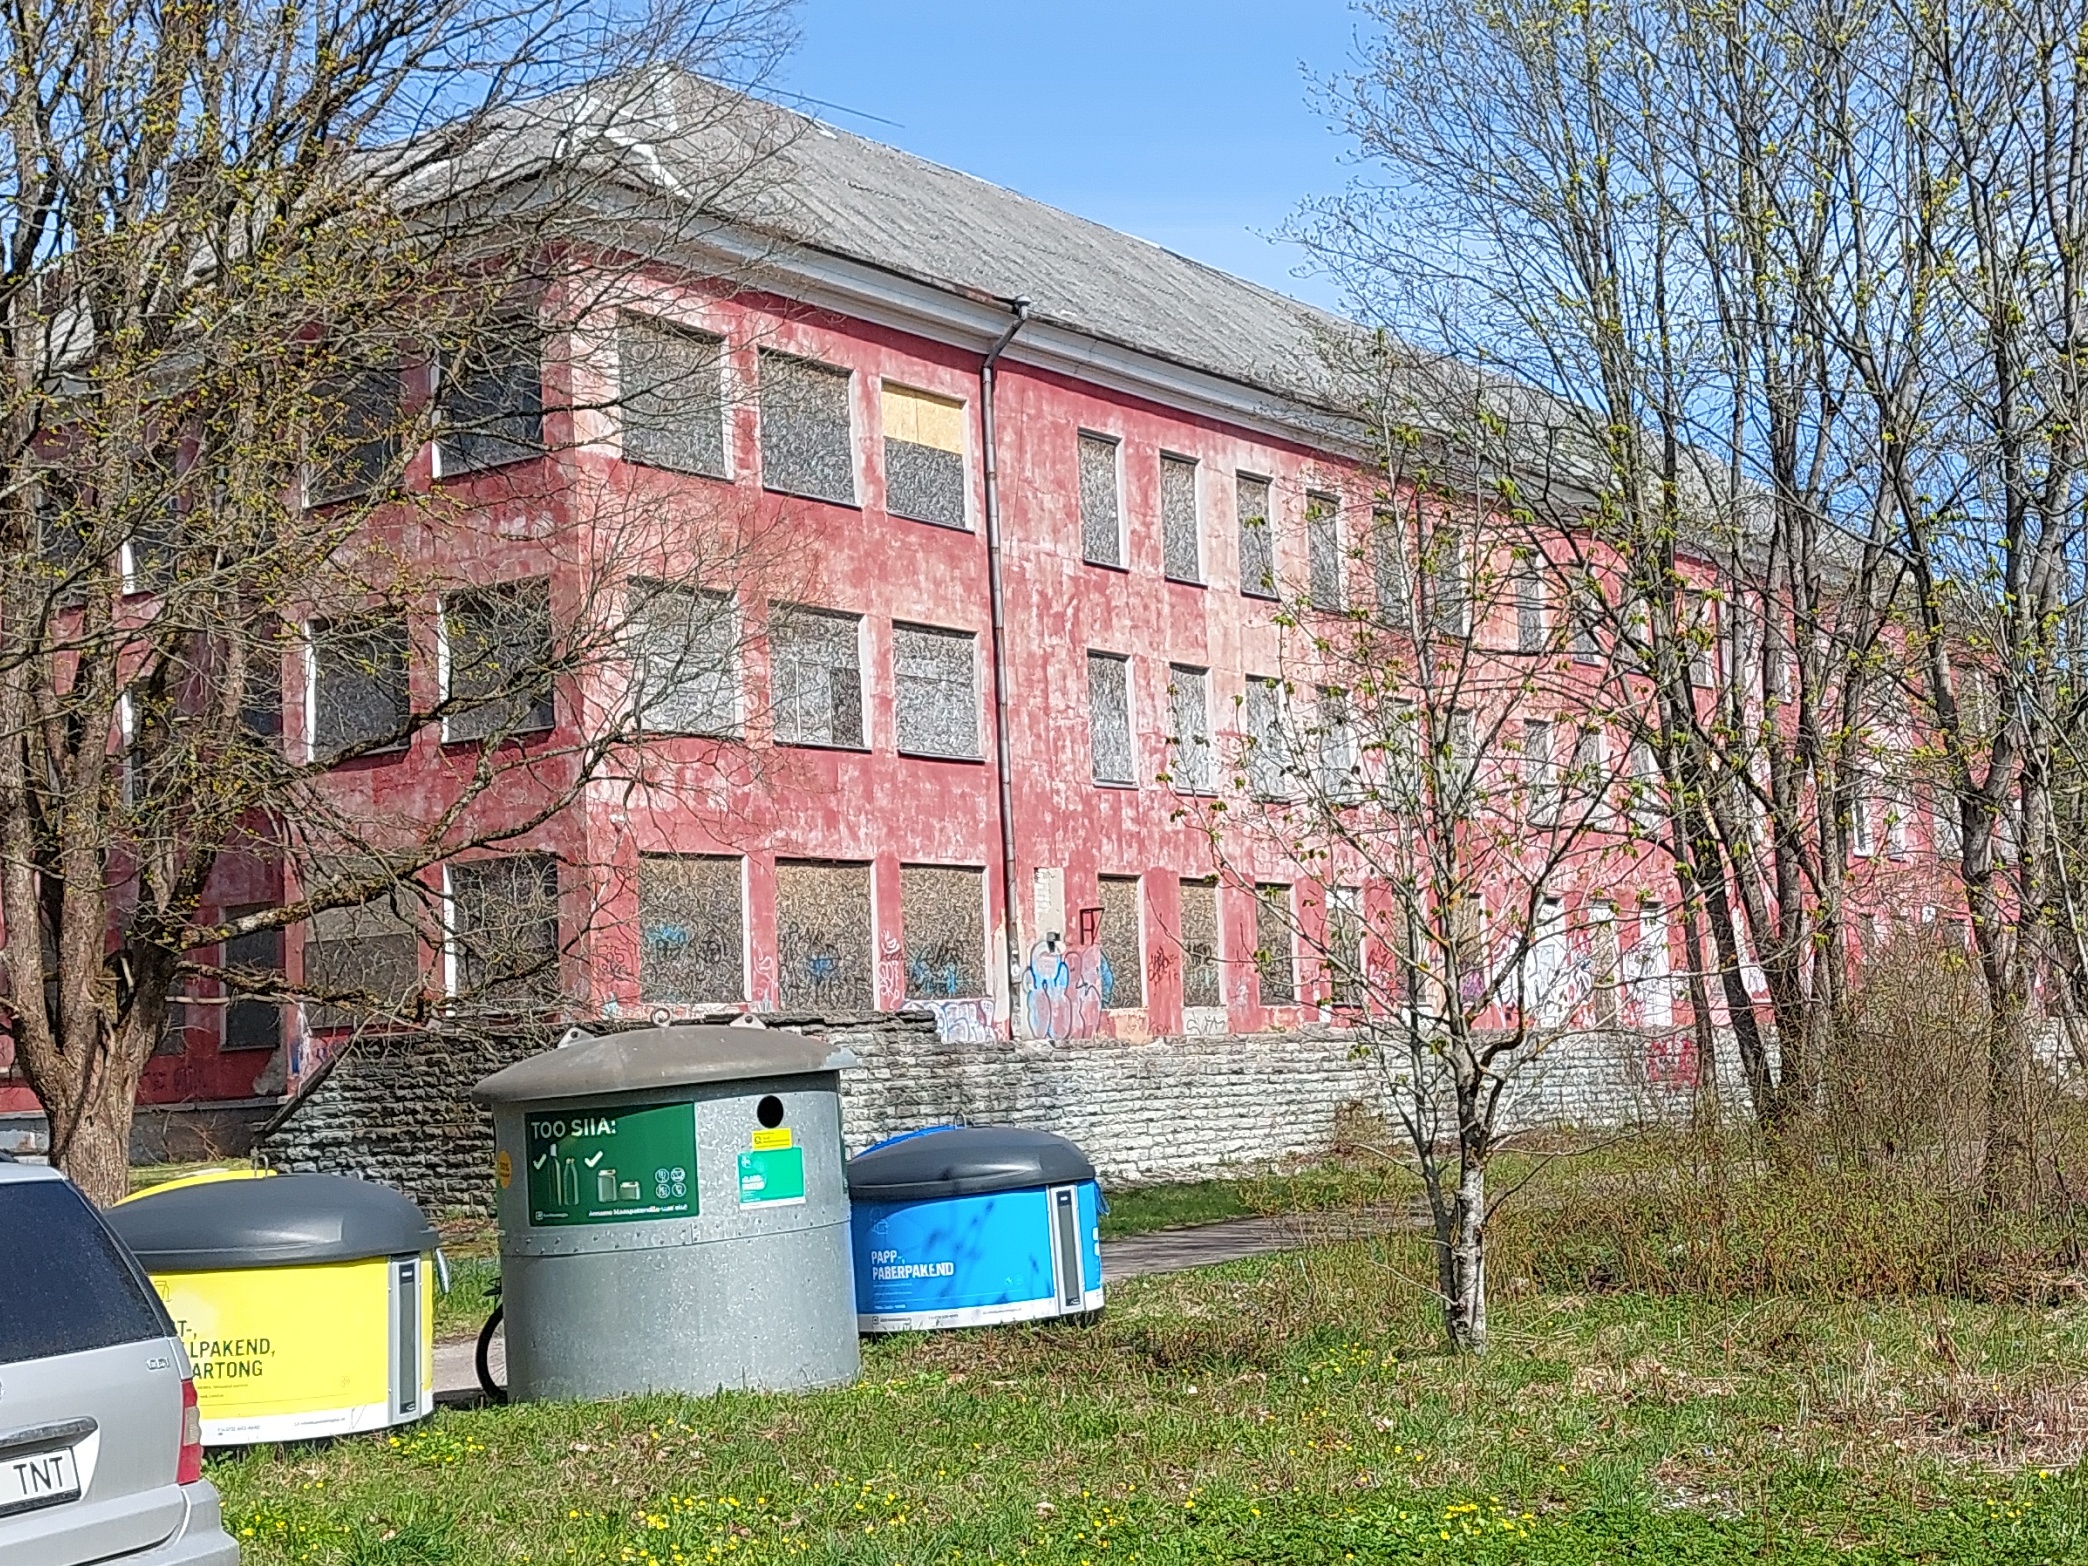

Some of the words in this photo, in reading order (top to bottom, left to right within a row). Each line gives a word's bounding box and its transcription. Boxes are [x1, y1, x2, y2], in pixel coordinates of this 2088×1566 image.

[531, 1120, 566, 1140] TOO
[571, 1117, 617, 1136] SIIA:
[872, 1262, 954, 1280] PABERPAKEND
[187, 1338, 275, 1358] LPAKEND,
[13, 1456, 63, 1495] TNT
